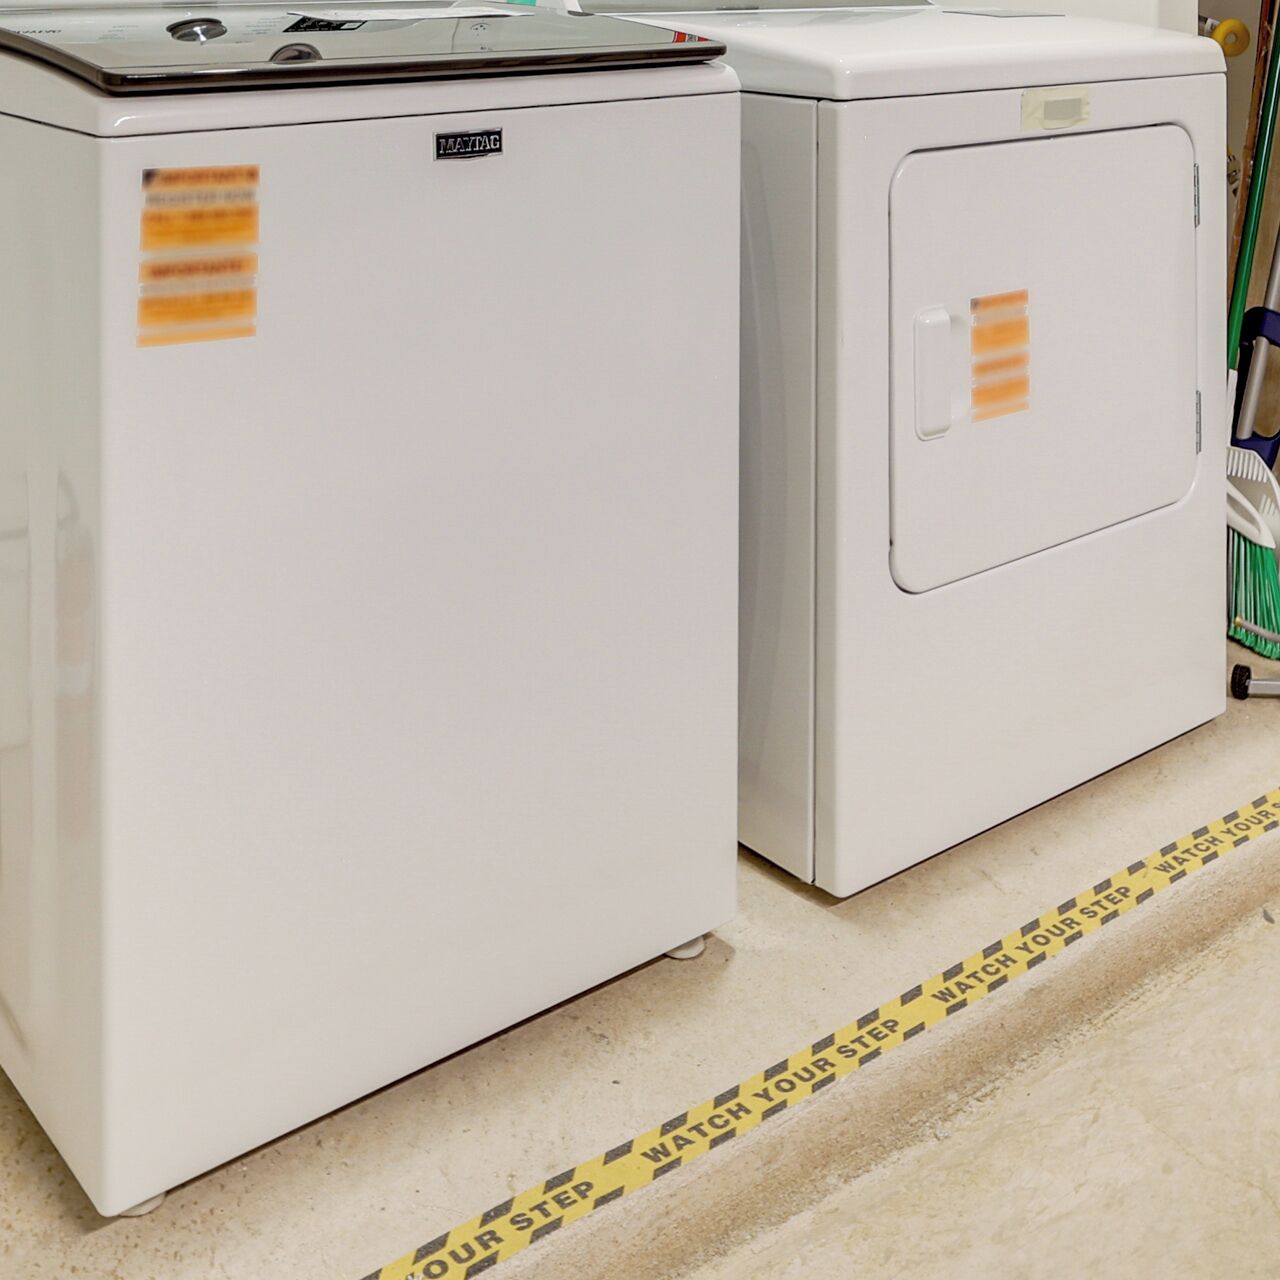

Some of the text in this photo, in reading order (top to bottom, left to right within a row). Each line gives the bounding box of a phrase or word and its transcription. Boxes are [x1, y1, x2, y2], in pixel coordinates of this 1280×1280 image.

[439, 135, 500, 154] MAYTAG
[1153, 835, 1221, 874] WATCH
[1220, 810, 1276, 838] YOUR
[931, 886, 1131, 1004] WATCH YOUR STEP
[640, 1018, 900, 1164] WATCH YOUR STEP
[509, 1180, 594, 1231] STEP
